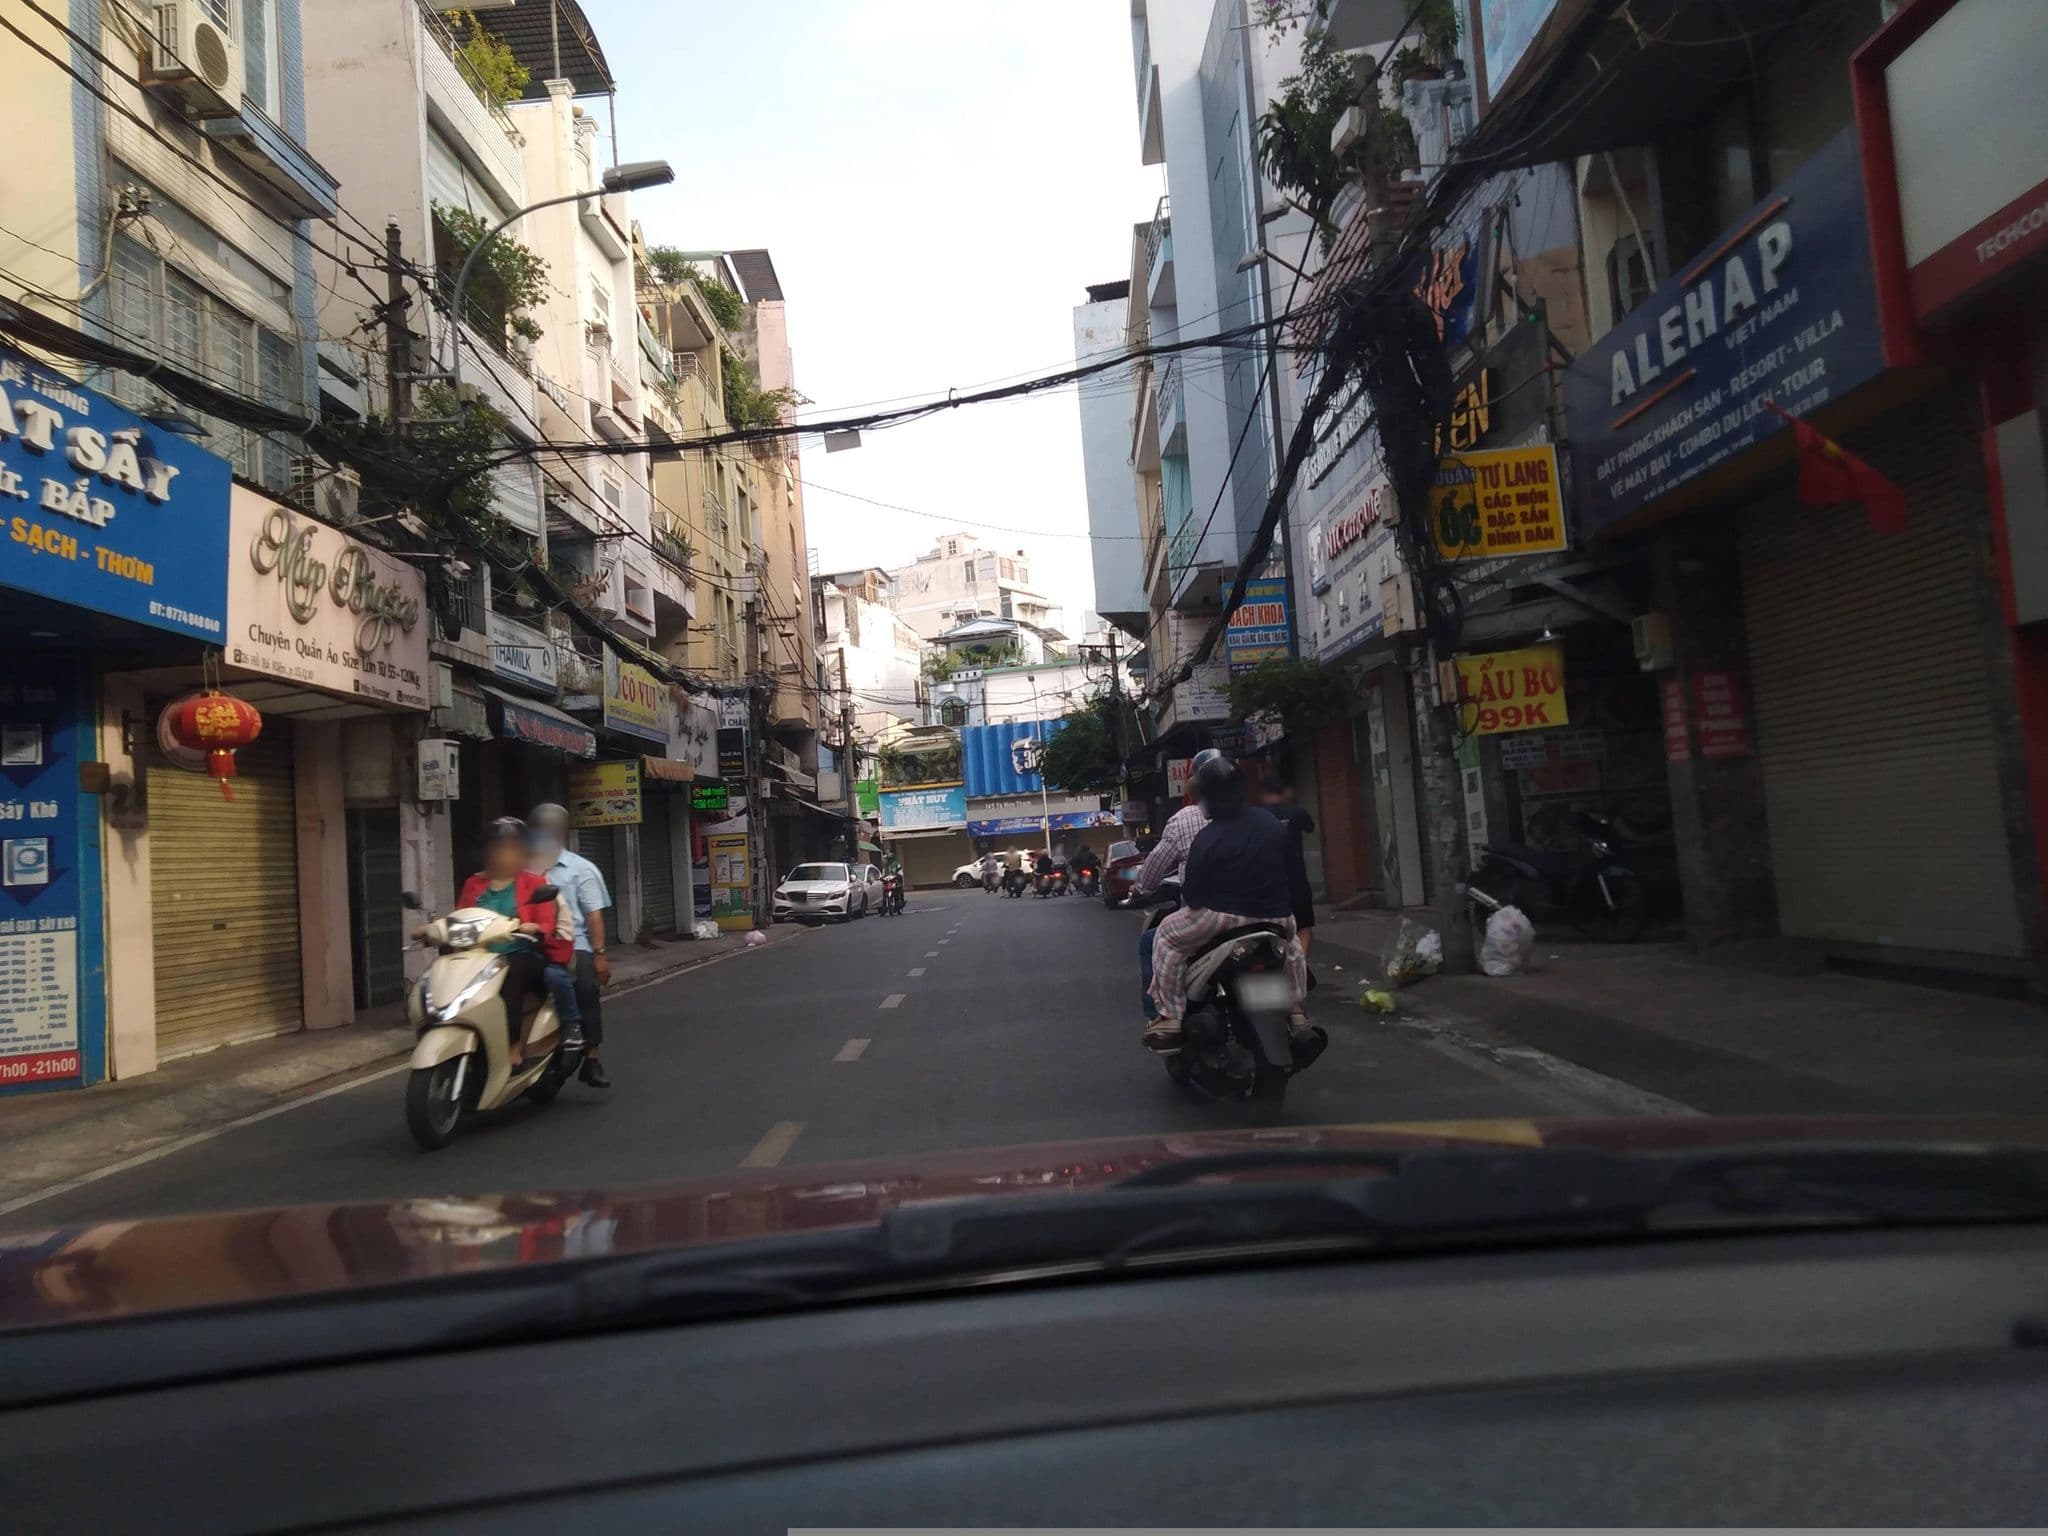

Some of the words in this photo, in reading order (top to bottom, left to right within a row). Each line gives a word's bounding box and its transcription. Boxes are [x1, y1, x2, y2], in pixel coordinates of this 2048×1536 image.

[1611, 221, 1793, 408] ALEHAP
[1729, 346, 1786, 396] RESORT
[1793, 309, 1845, 353] VILLA
[1678, 421, 1722, 460] COMBO
[1780, 357, 1827, 395] TOUR
[66, 427, 180, 501] SẤY
[1503, 459, 1549, 488] LANG
[1483, 491, 1512, 510] CÁC
[1515, 488, 1549, 507] MÓN
[11, 515, 77, 561] SẠCH
[96, 545, 155, 586] THƠM
[1257, 604, 1285, 625] KHOA
[248, 623, 290, 655] Chuyên
[295, 636, 322, 660] Quần
[326, 642, 338, 665] Áo
[342, 651, 359, 670] Size
[622, 671, 636, 704] CÔ
[1479, 702, 1549, 731] 99K
